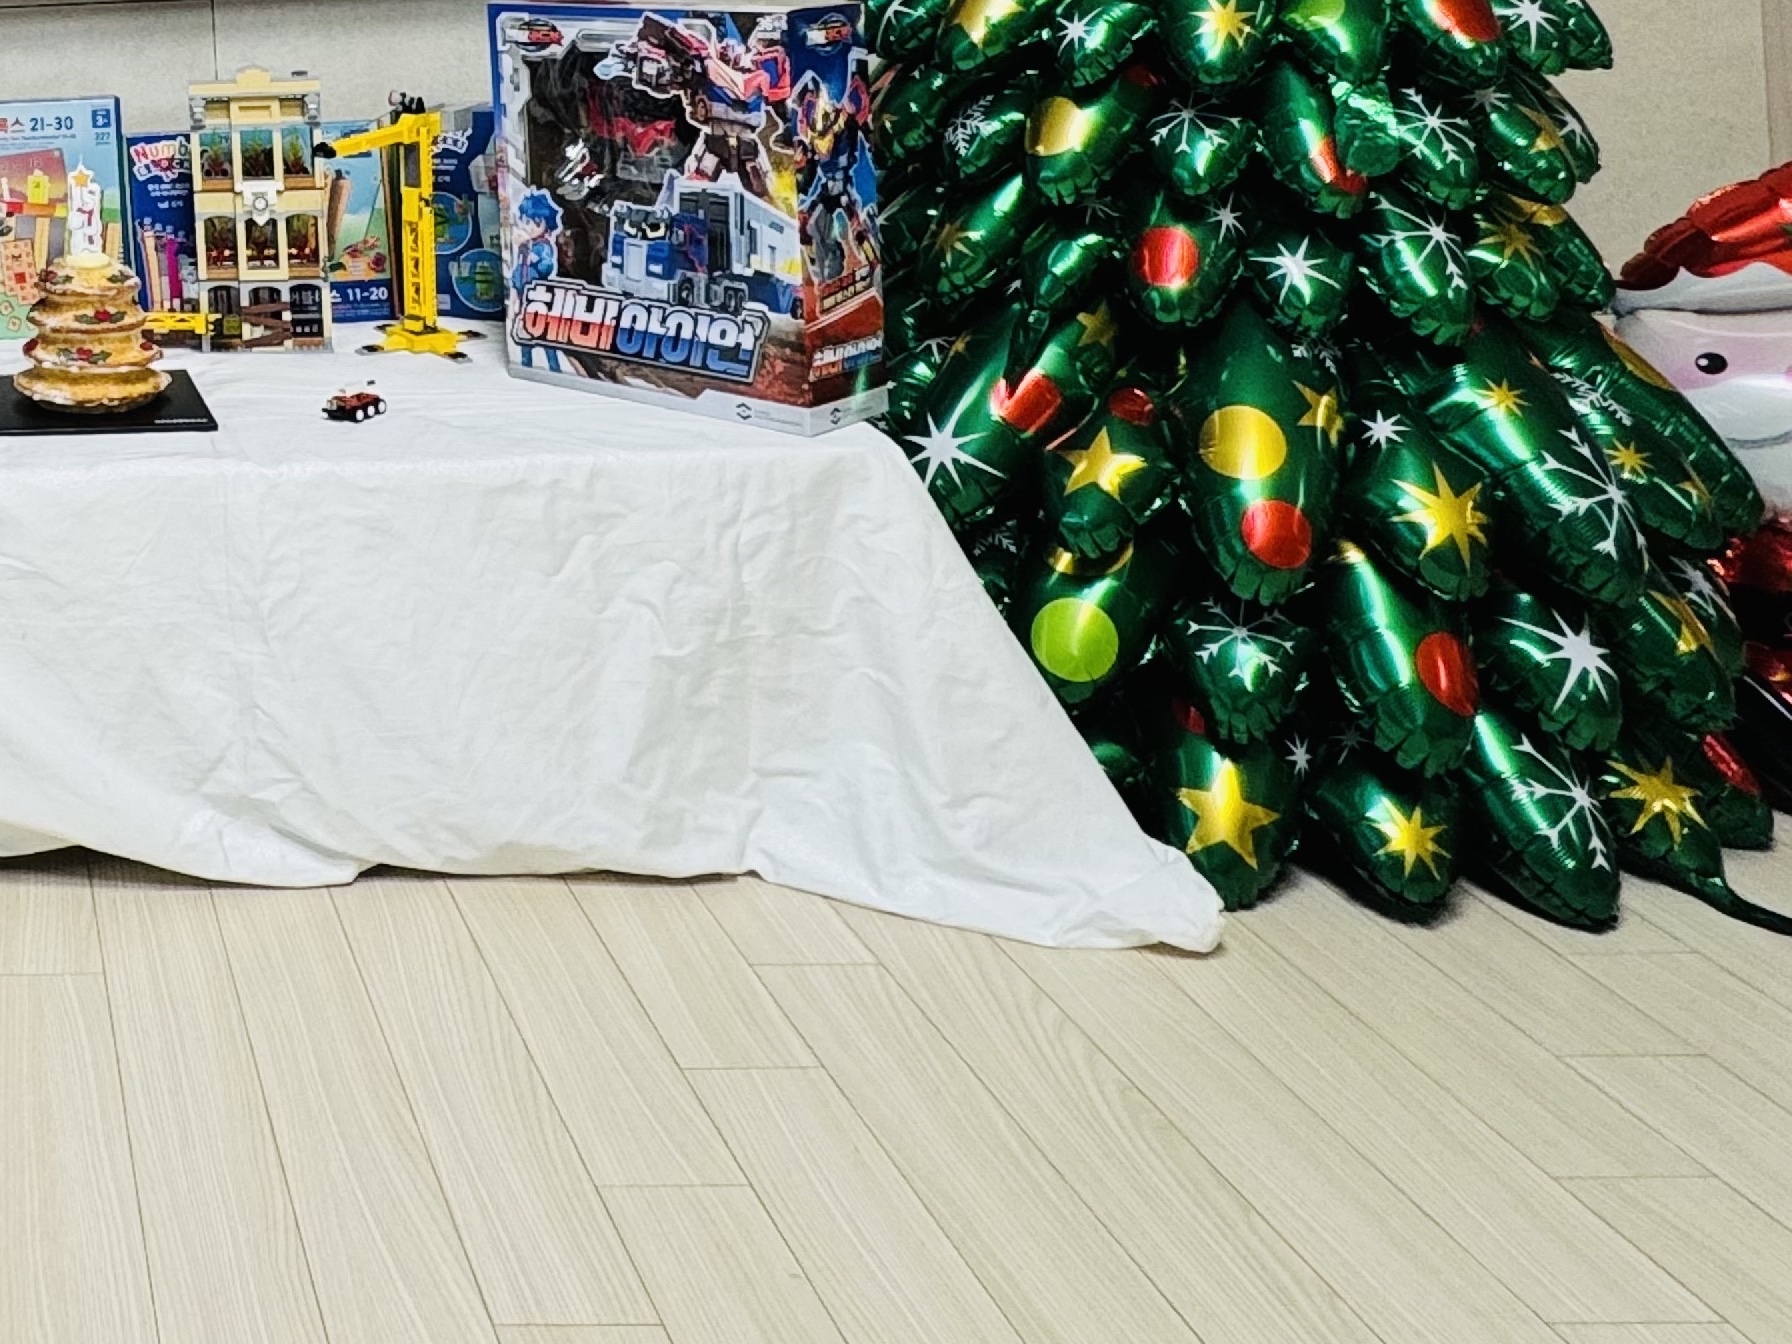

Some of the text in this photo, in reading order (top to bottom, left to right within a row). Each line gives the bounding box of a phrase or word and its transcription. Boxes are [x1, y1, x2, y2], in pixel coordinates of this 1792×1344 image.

[29, 116, 74, 132] 21-30
[134, 140, 189, 163] Numb
[347, 287, 389, 302] 11-20
